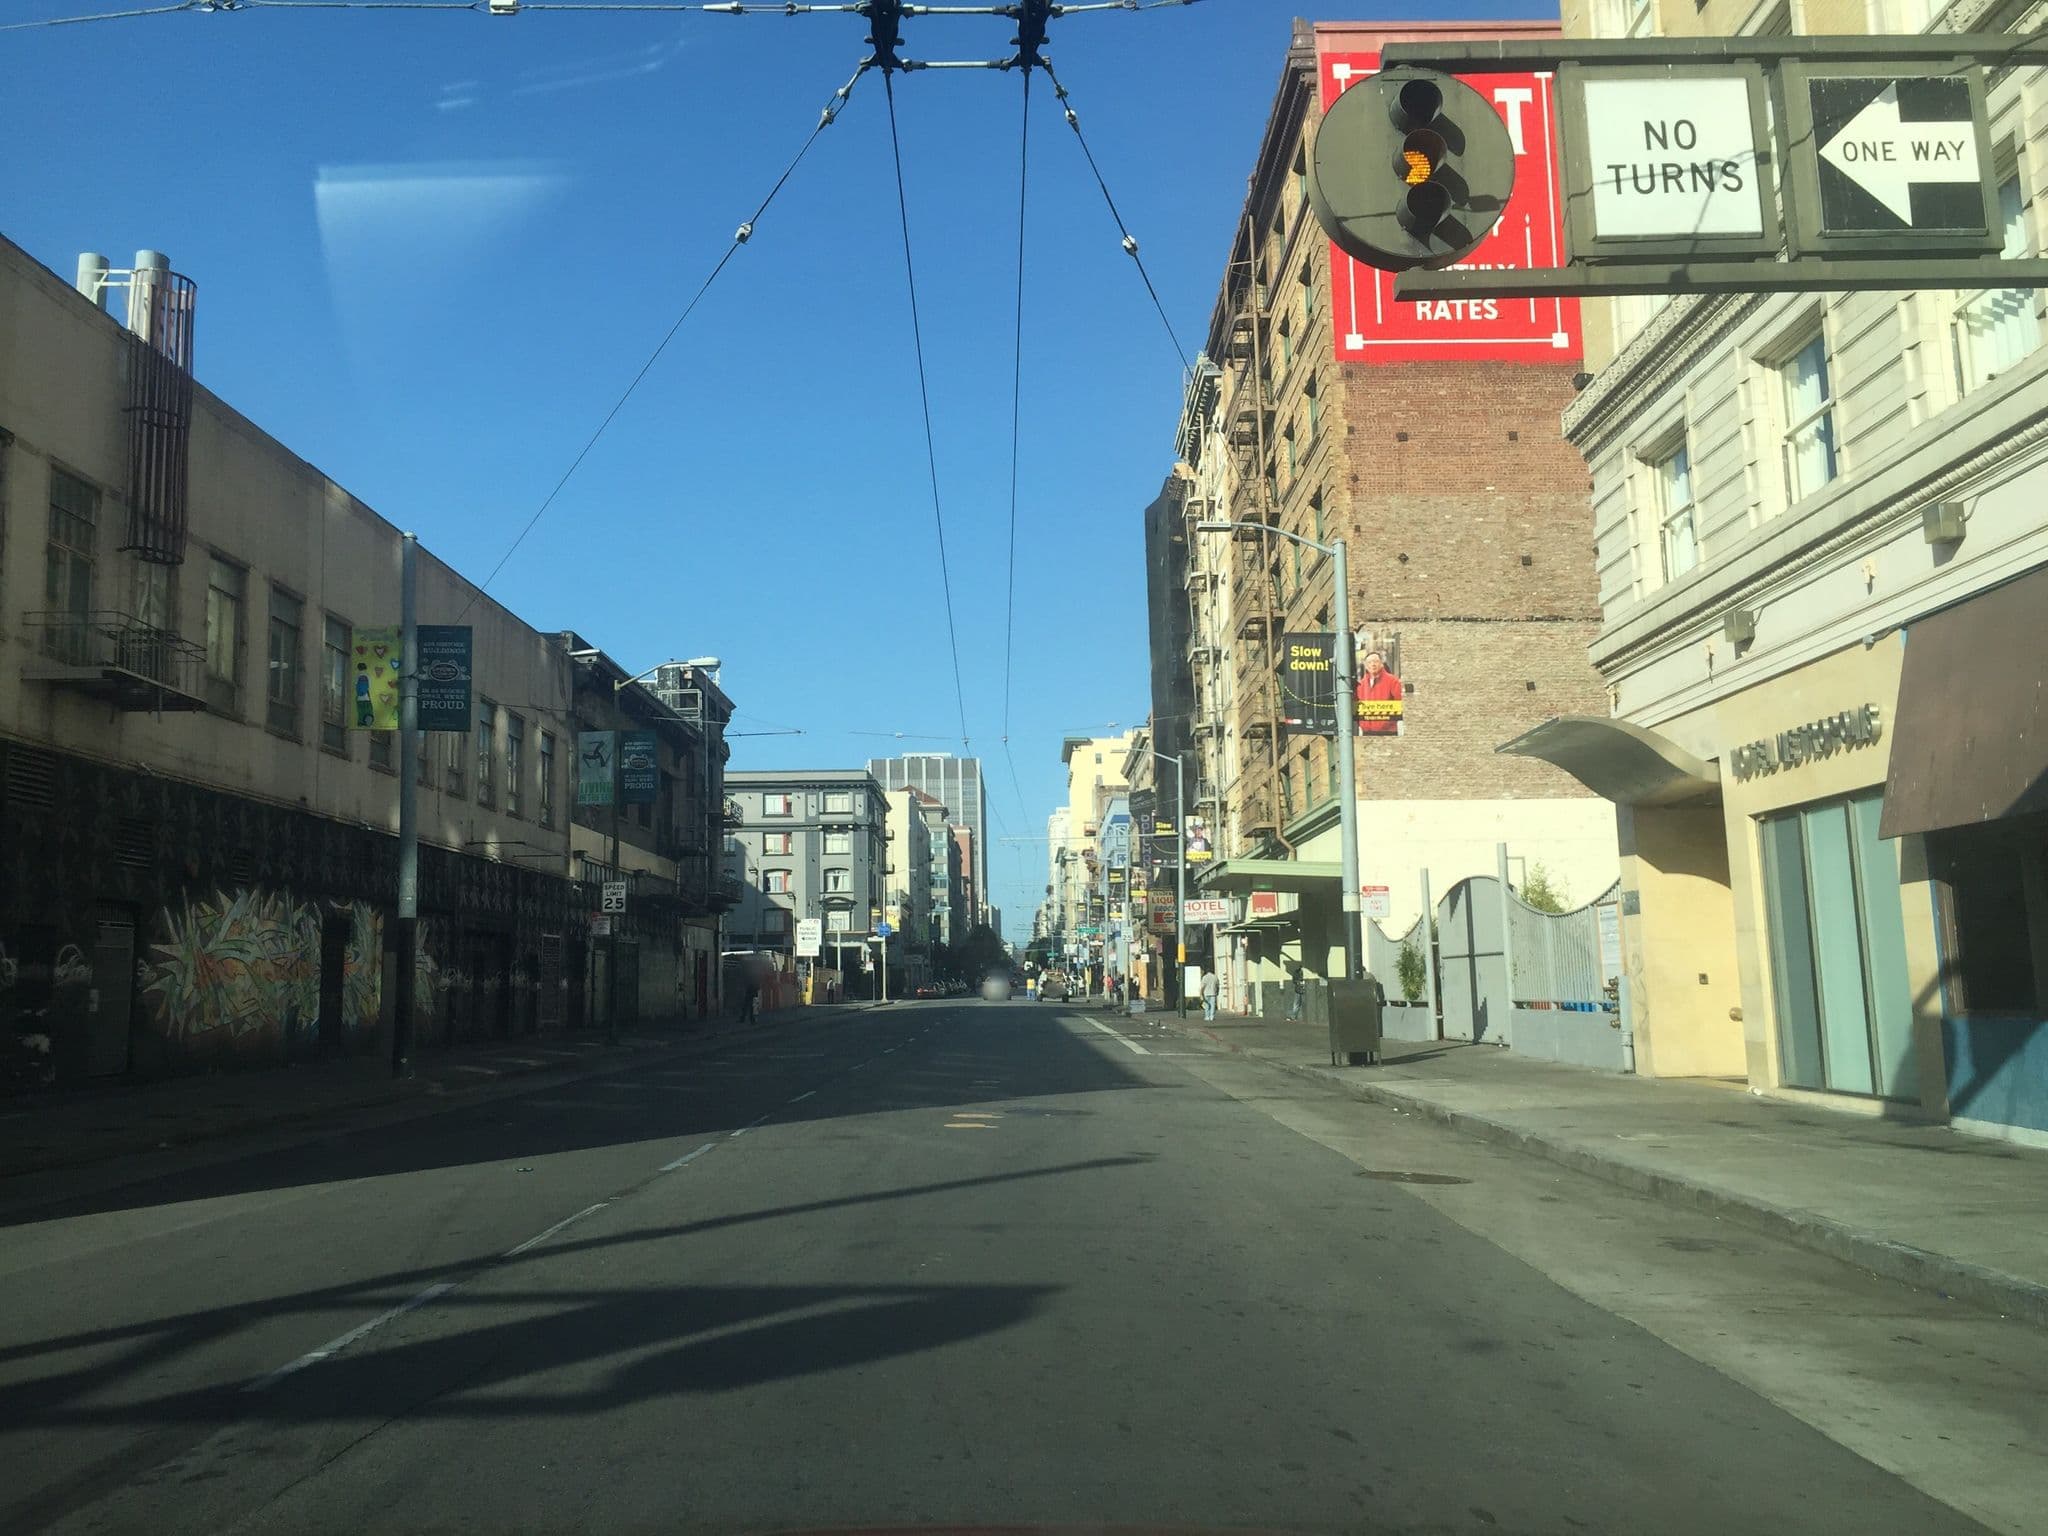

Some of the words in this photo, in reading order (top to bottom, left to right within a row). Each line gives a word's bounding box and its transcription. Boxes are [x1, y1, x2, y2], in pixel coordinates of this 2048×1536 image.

[1644, 119, 1698, 152] NO
[1842, 140, 1898, 163] ONE
[1911, 140, 1966, 163] WAY
[1607, 162, 1744, 197] TURNS
[1415, 298, 1499, 321] RATES
[1290, 645, 1322, 657] Slow
[1290, 658, 1329, 671] down!
[604, 897, 624, 909] 25
[1183, 901, 1225, 912] HOTEL
